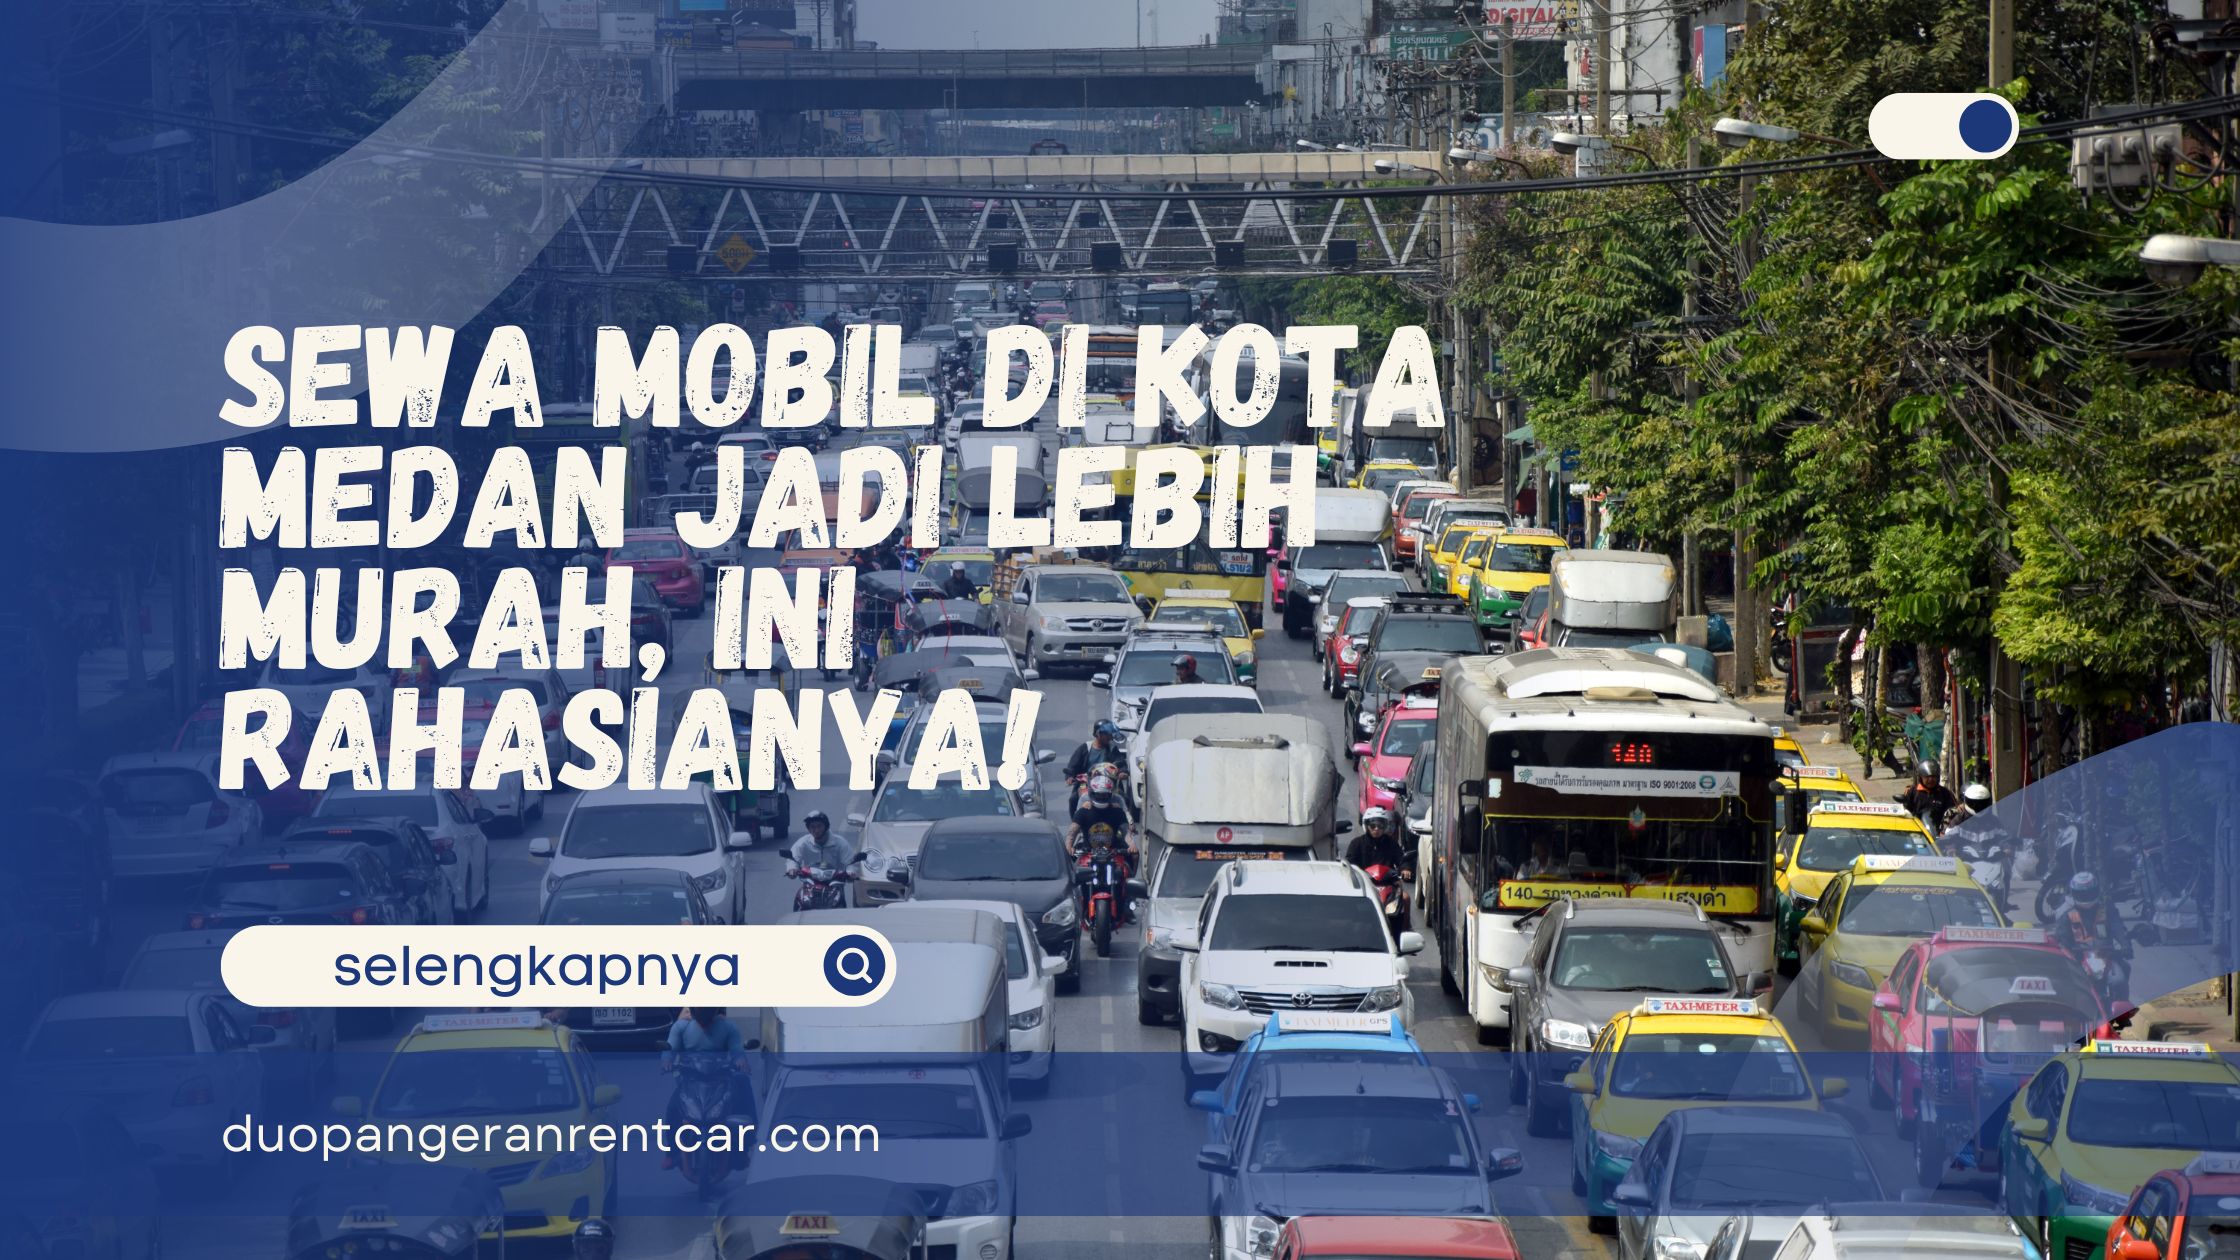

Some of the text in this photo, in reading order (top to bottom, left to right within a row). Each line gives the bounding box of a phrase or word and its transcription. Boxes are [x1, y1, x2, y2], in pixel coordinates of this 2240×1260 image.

[1488, 7, 1553, 24] DIGITAL
[1649, 780, 1661, 789] ISO
[1663, 780, 1697, 790] 9001:2008
[1838, 805, 1890, 813] TAXI-METER
[1506, 886, 1533, 900] 140
[2020, 980, 2046, 991] TAXI
[1663, 1001, 1739, 1012] TAXI-METER
[612, 1008, 632, 1017] 1102
[2115, 1045, 2190, 1056] TAXI-METER
[352, 1209, 385, 1223] TAXI
[792, 1215, 827, 1229] TAXI
